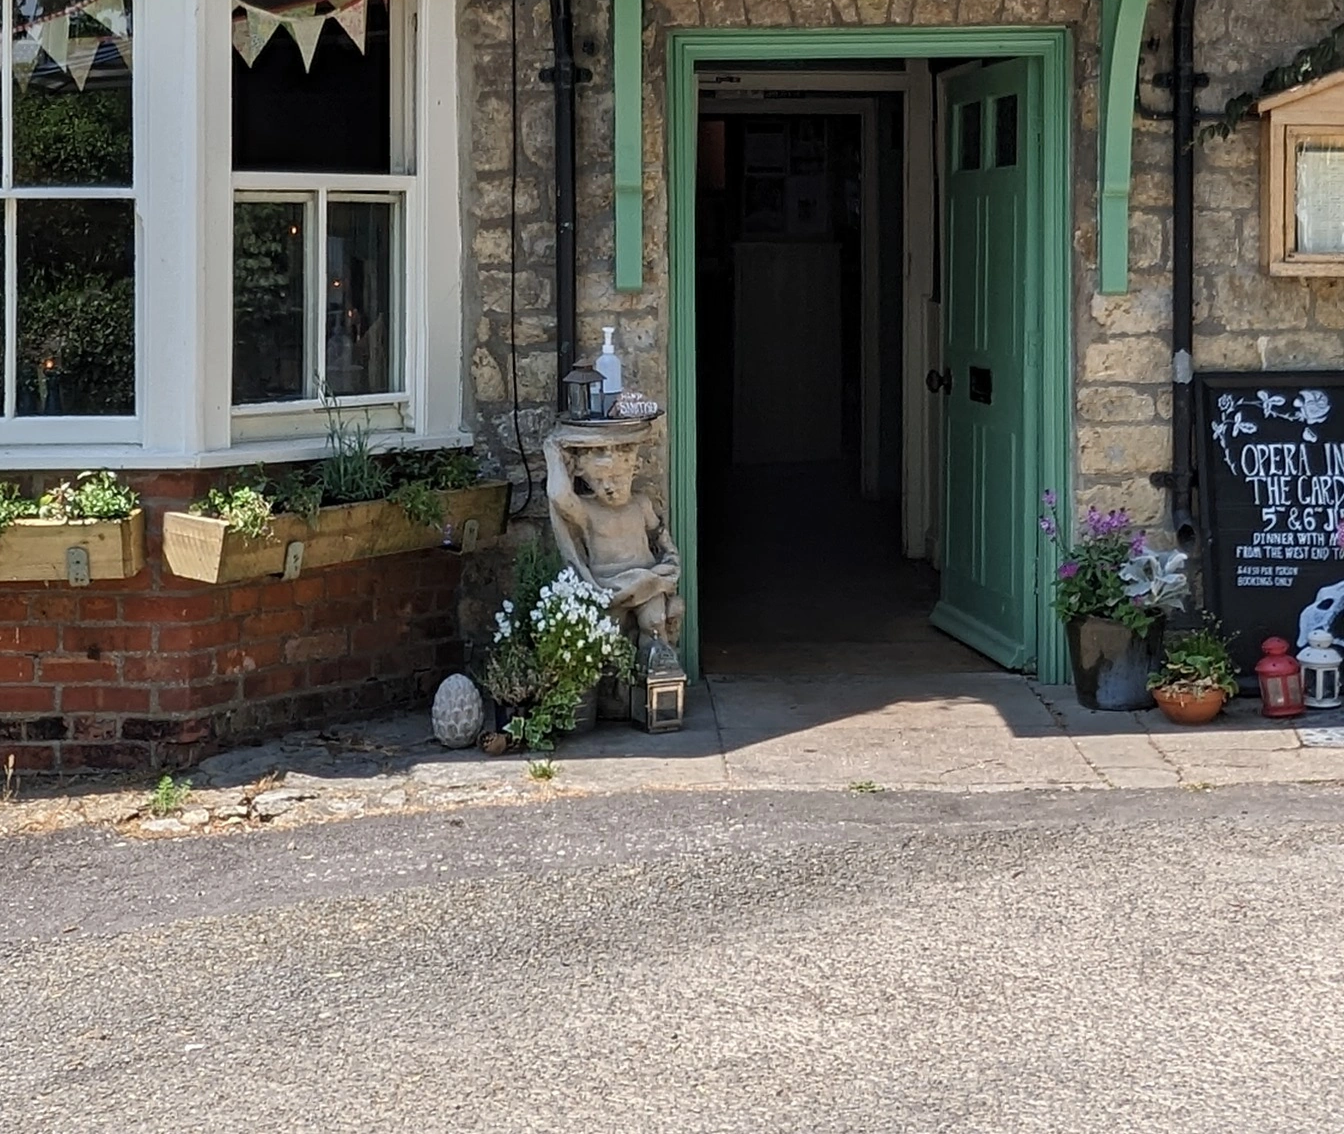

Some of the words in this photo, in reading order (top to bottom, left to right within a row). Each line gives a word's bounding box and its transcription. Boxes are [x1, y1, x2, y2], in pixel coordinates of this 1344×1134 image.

[1241, 443, 1311, 477] OPERA
[1245, 475, 1292, 506] THE
[1287, 507, 1303, 531] &
[1253, 532, 1294, 545] DINNER
[1296, 533, 1325, 546] WITH
[1236, 546, 1262, 559] FROM
[1263, 546, 1283, 559] THE
[1284, 547, 1309, 560] WEST
[1311, 547, 1330, 561] END
